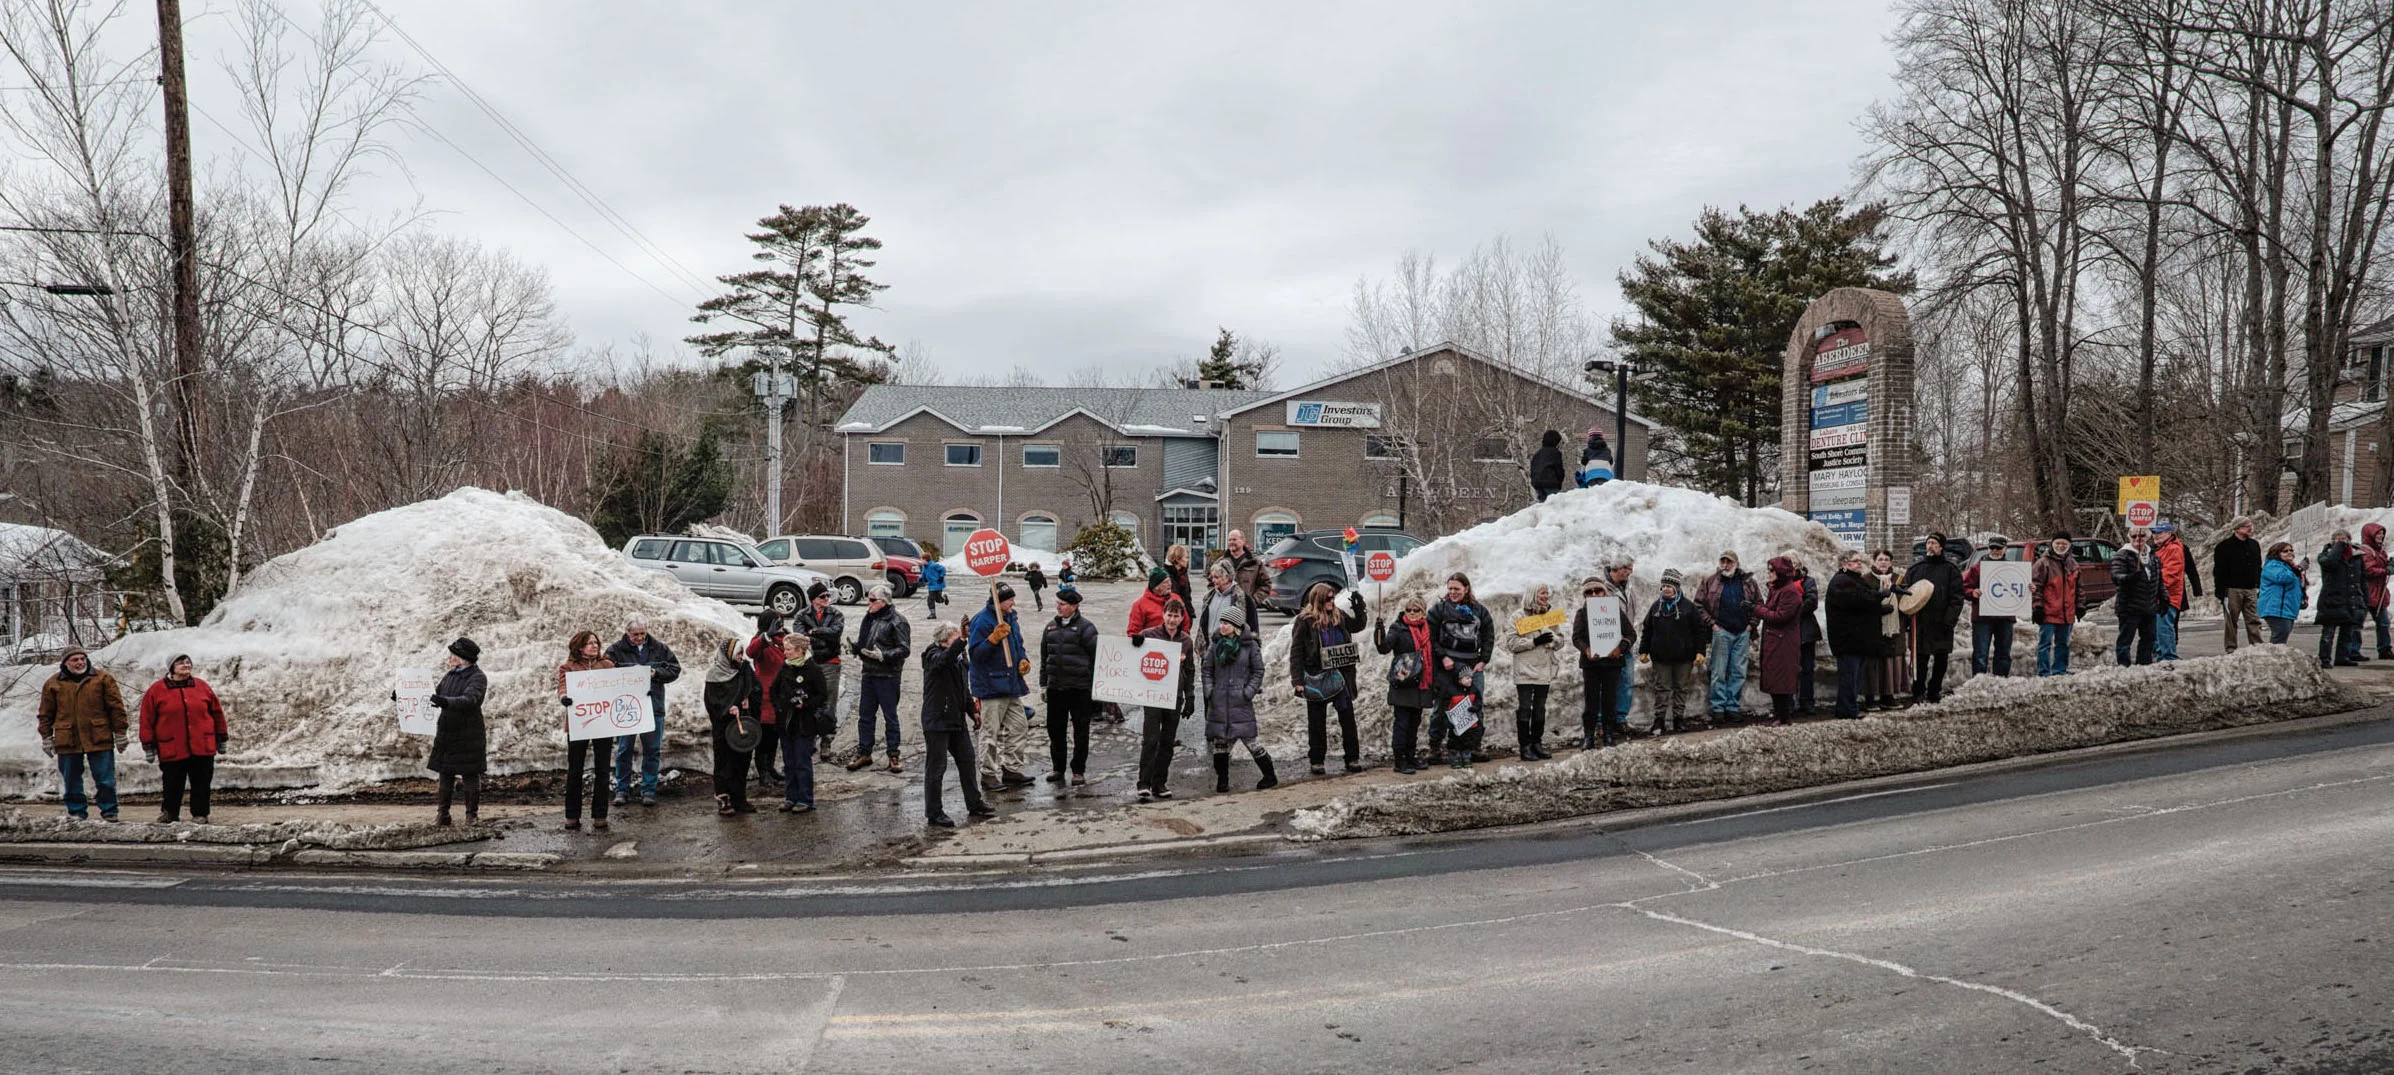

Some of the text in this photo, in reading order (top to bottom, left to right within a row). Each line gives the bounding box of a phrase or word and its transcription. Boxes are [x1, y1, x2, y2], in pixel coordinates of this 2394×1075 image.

[1836, 338, 1849, 347] The
[1323, 404, 1373, 415] Investors
[1321, 414, 1352, 425] Group
[1811, 434, 1847, 448] DENTURE
[1811, 451, 1826, 460] South
[1827, 449, 1843, 458] Shore
[1823, 455, 1864, 467] Justice Society
[1814, 472, 1835, 481] MARY
[2130, 508, 2153, 516] STOP
[970, 538, 1003, 556] STOP
[971, 553, 1007, 567] HARPER
[1370, 559, 1392, 569] STOP
[1991, 582, 2023, 598] C-51
[1592, 617, 1617, 626] CHAIRMAN
[1597, 632, 1615, 640] HARPER
[1143, 657, 1167, 668] STOP
[1142, 667, 1167, 675] HARPER
[575, 701, 610, 717] STOP
